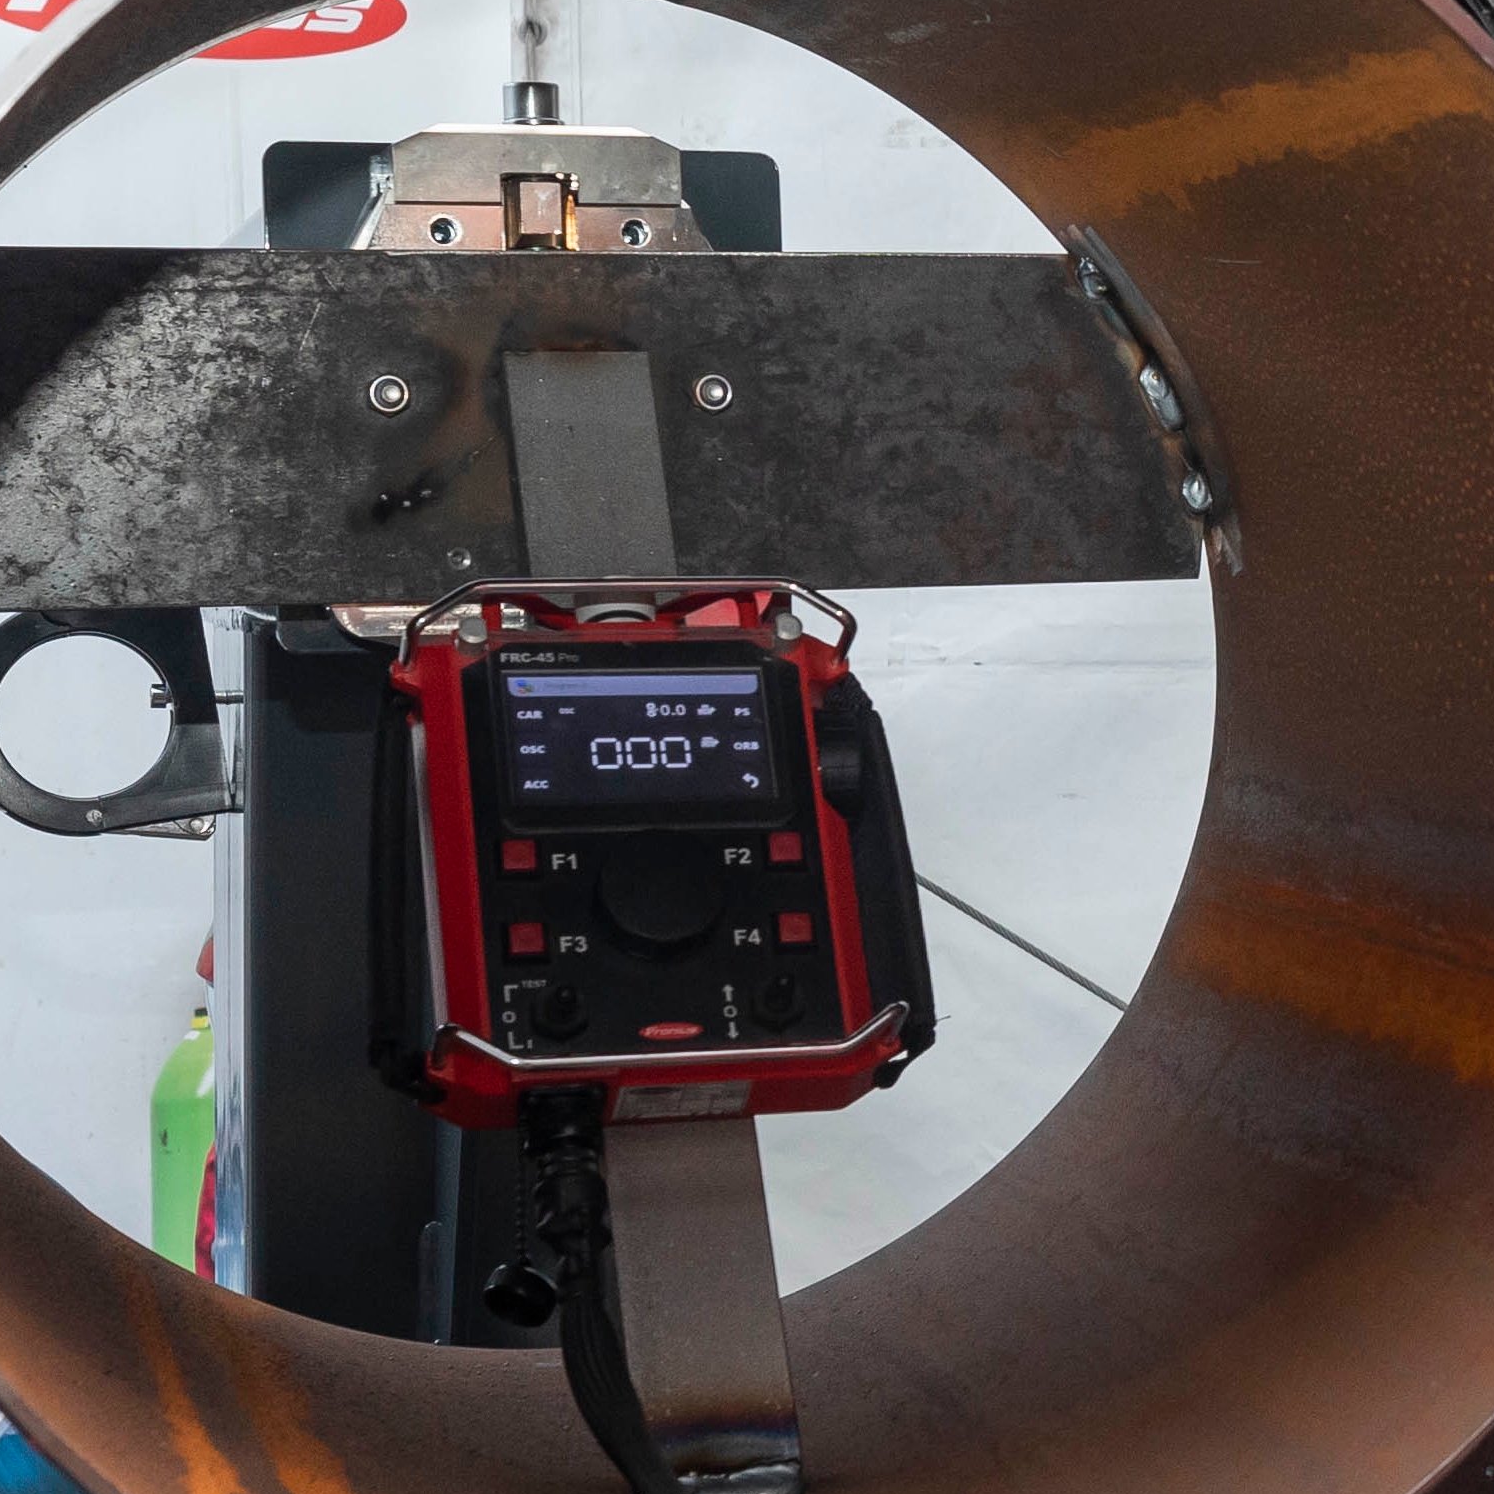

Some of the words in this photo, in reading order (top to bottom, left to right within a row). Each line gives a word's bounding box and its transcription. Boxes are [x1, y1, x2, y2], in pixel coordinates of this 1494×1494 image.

[500, 652, 555, 663] FRC-45
[517, 710, 543, 720] CAR
[520, 745, 545, 755] OSC
[734, 741, 759, 751] ORB
[590, 736, 692, 770] 000
[524, 779, 550, 790] ACC
[551, 854, 578, 870] F1
[723, 848, 752, 865] F2
[733, 929, 762, 946] F4
[559, 936, 589, 953] F3
